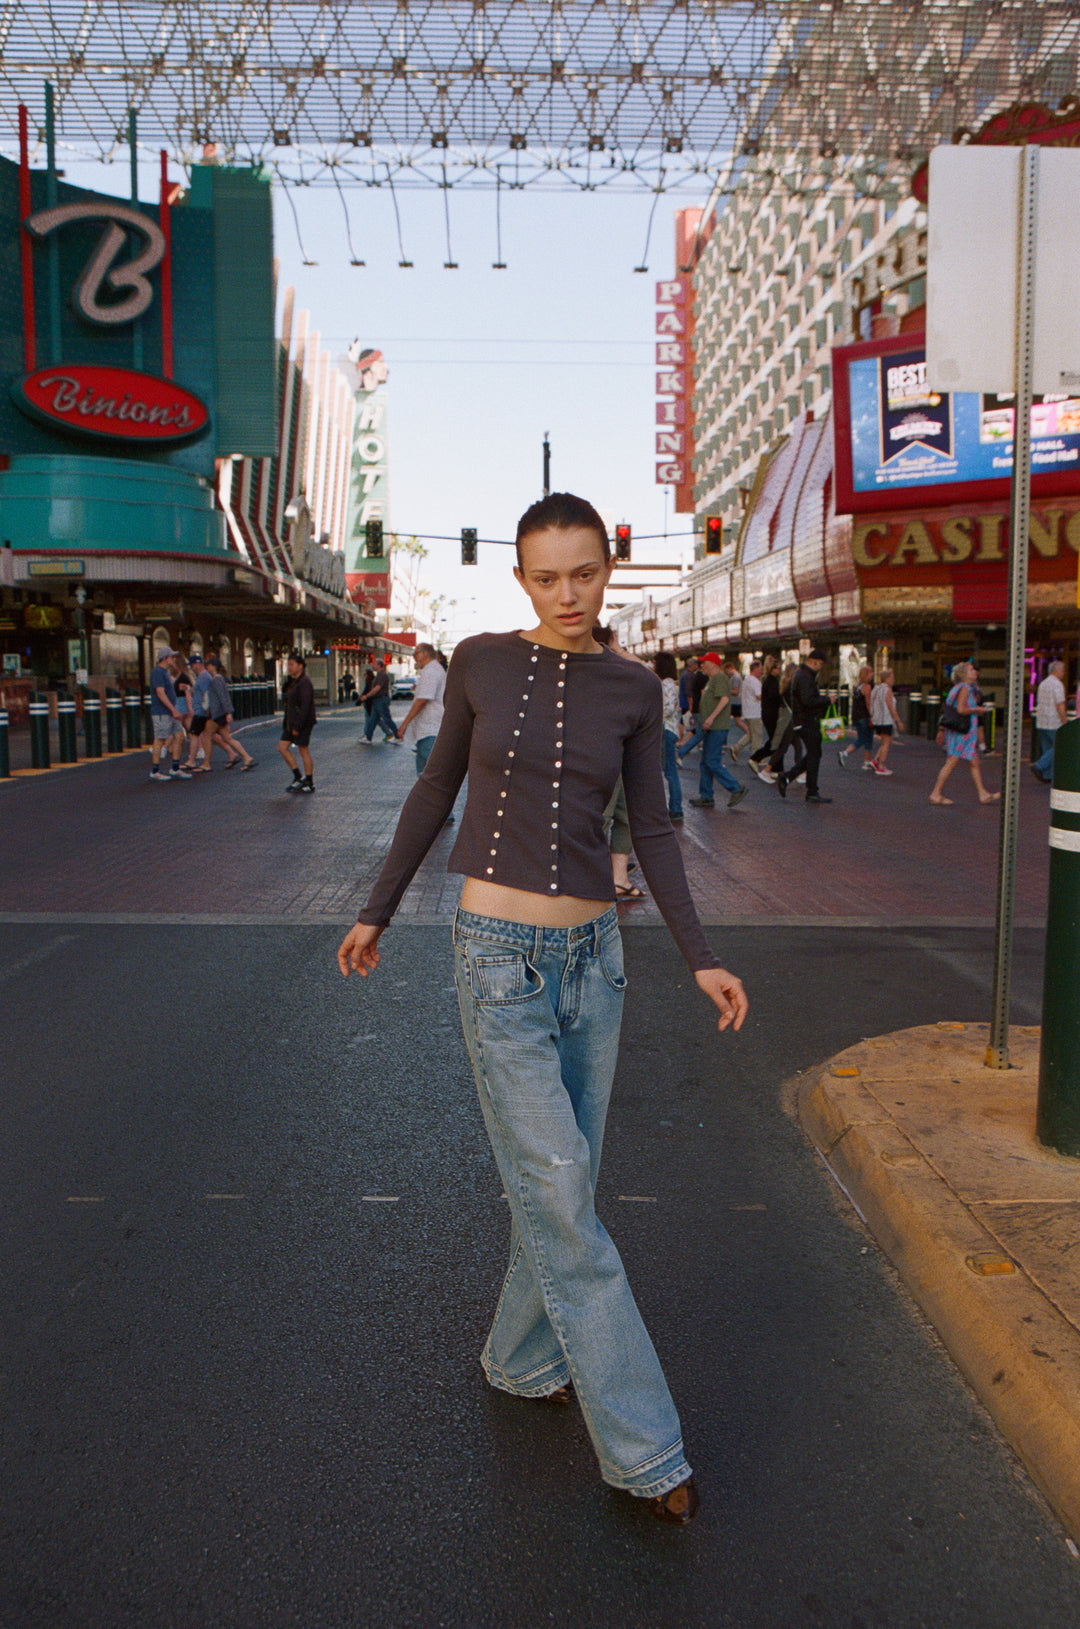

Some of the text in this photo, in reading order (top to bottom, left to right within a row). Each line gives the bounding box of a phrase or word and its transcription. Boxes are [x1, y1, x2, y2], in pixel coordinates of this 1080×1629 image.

[25, 202, 167, 324] B
[39, 375, 194, 428] Binion's
[657, 282, 683, 483] PARKING
[887, 361, 927, 390] BEST
[358, 403, 387, 558] HOTE
